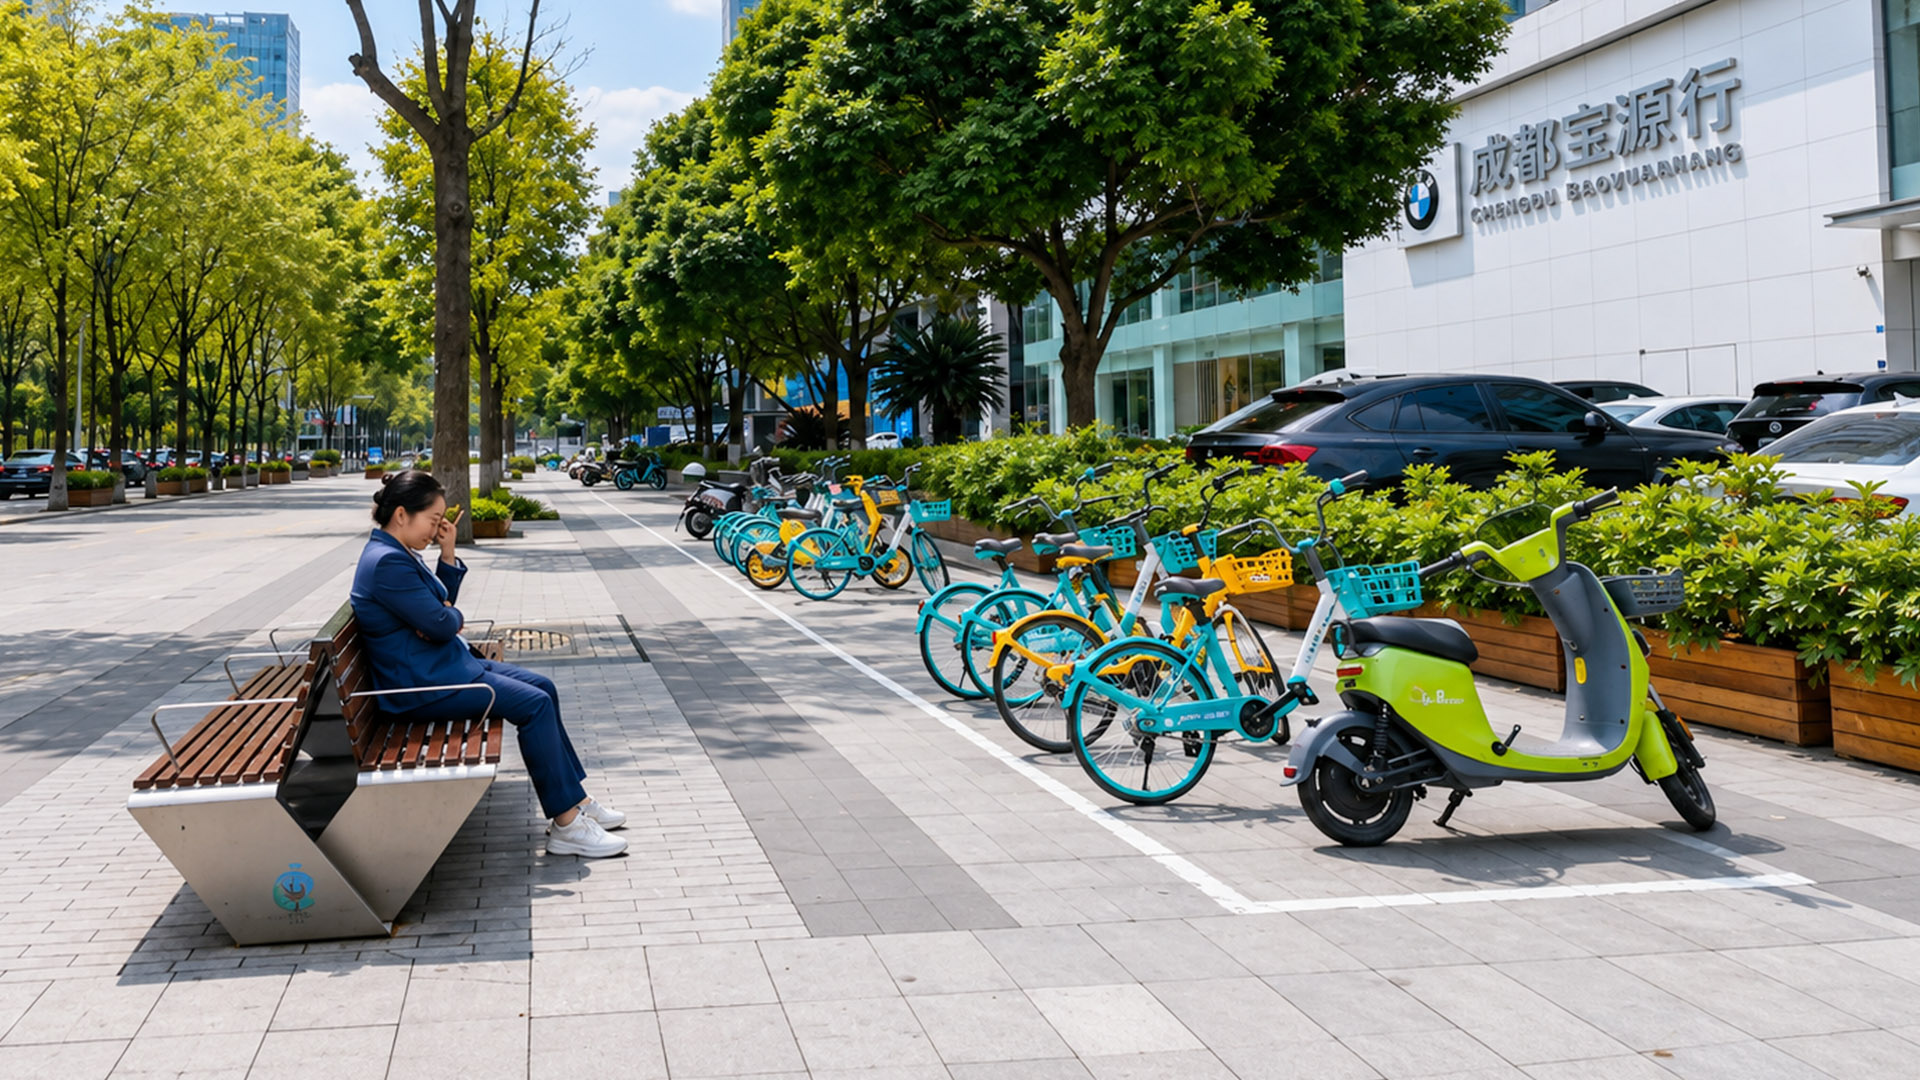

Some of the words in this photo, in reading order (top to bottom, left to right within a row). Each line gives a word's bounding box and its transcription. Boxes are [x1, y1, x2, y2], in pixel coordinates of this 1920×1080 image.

[1470, 57, 1741, 196] 成都宝源行
[1470, 188, 1558, 224] CHENGDU
